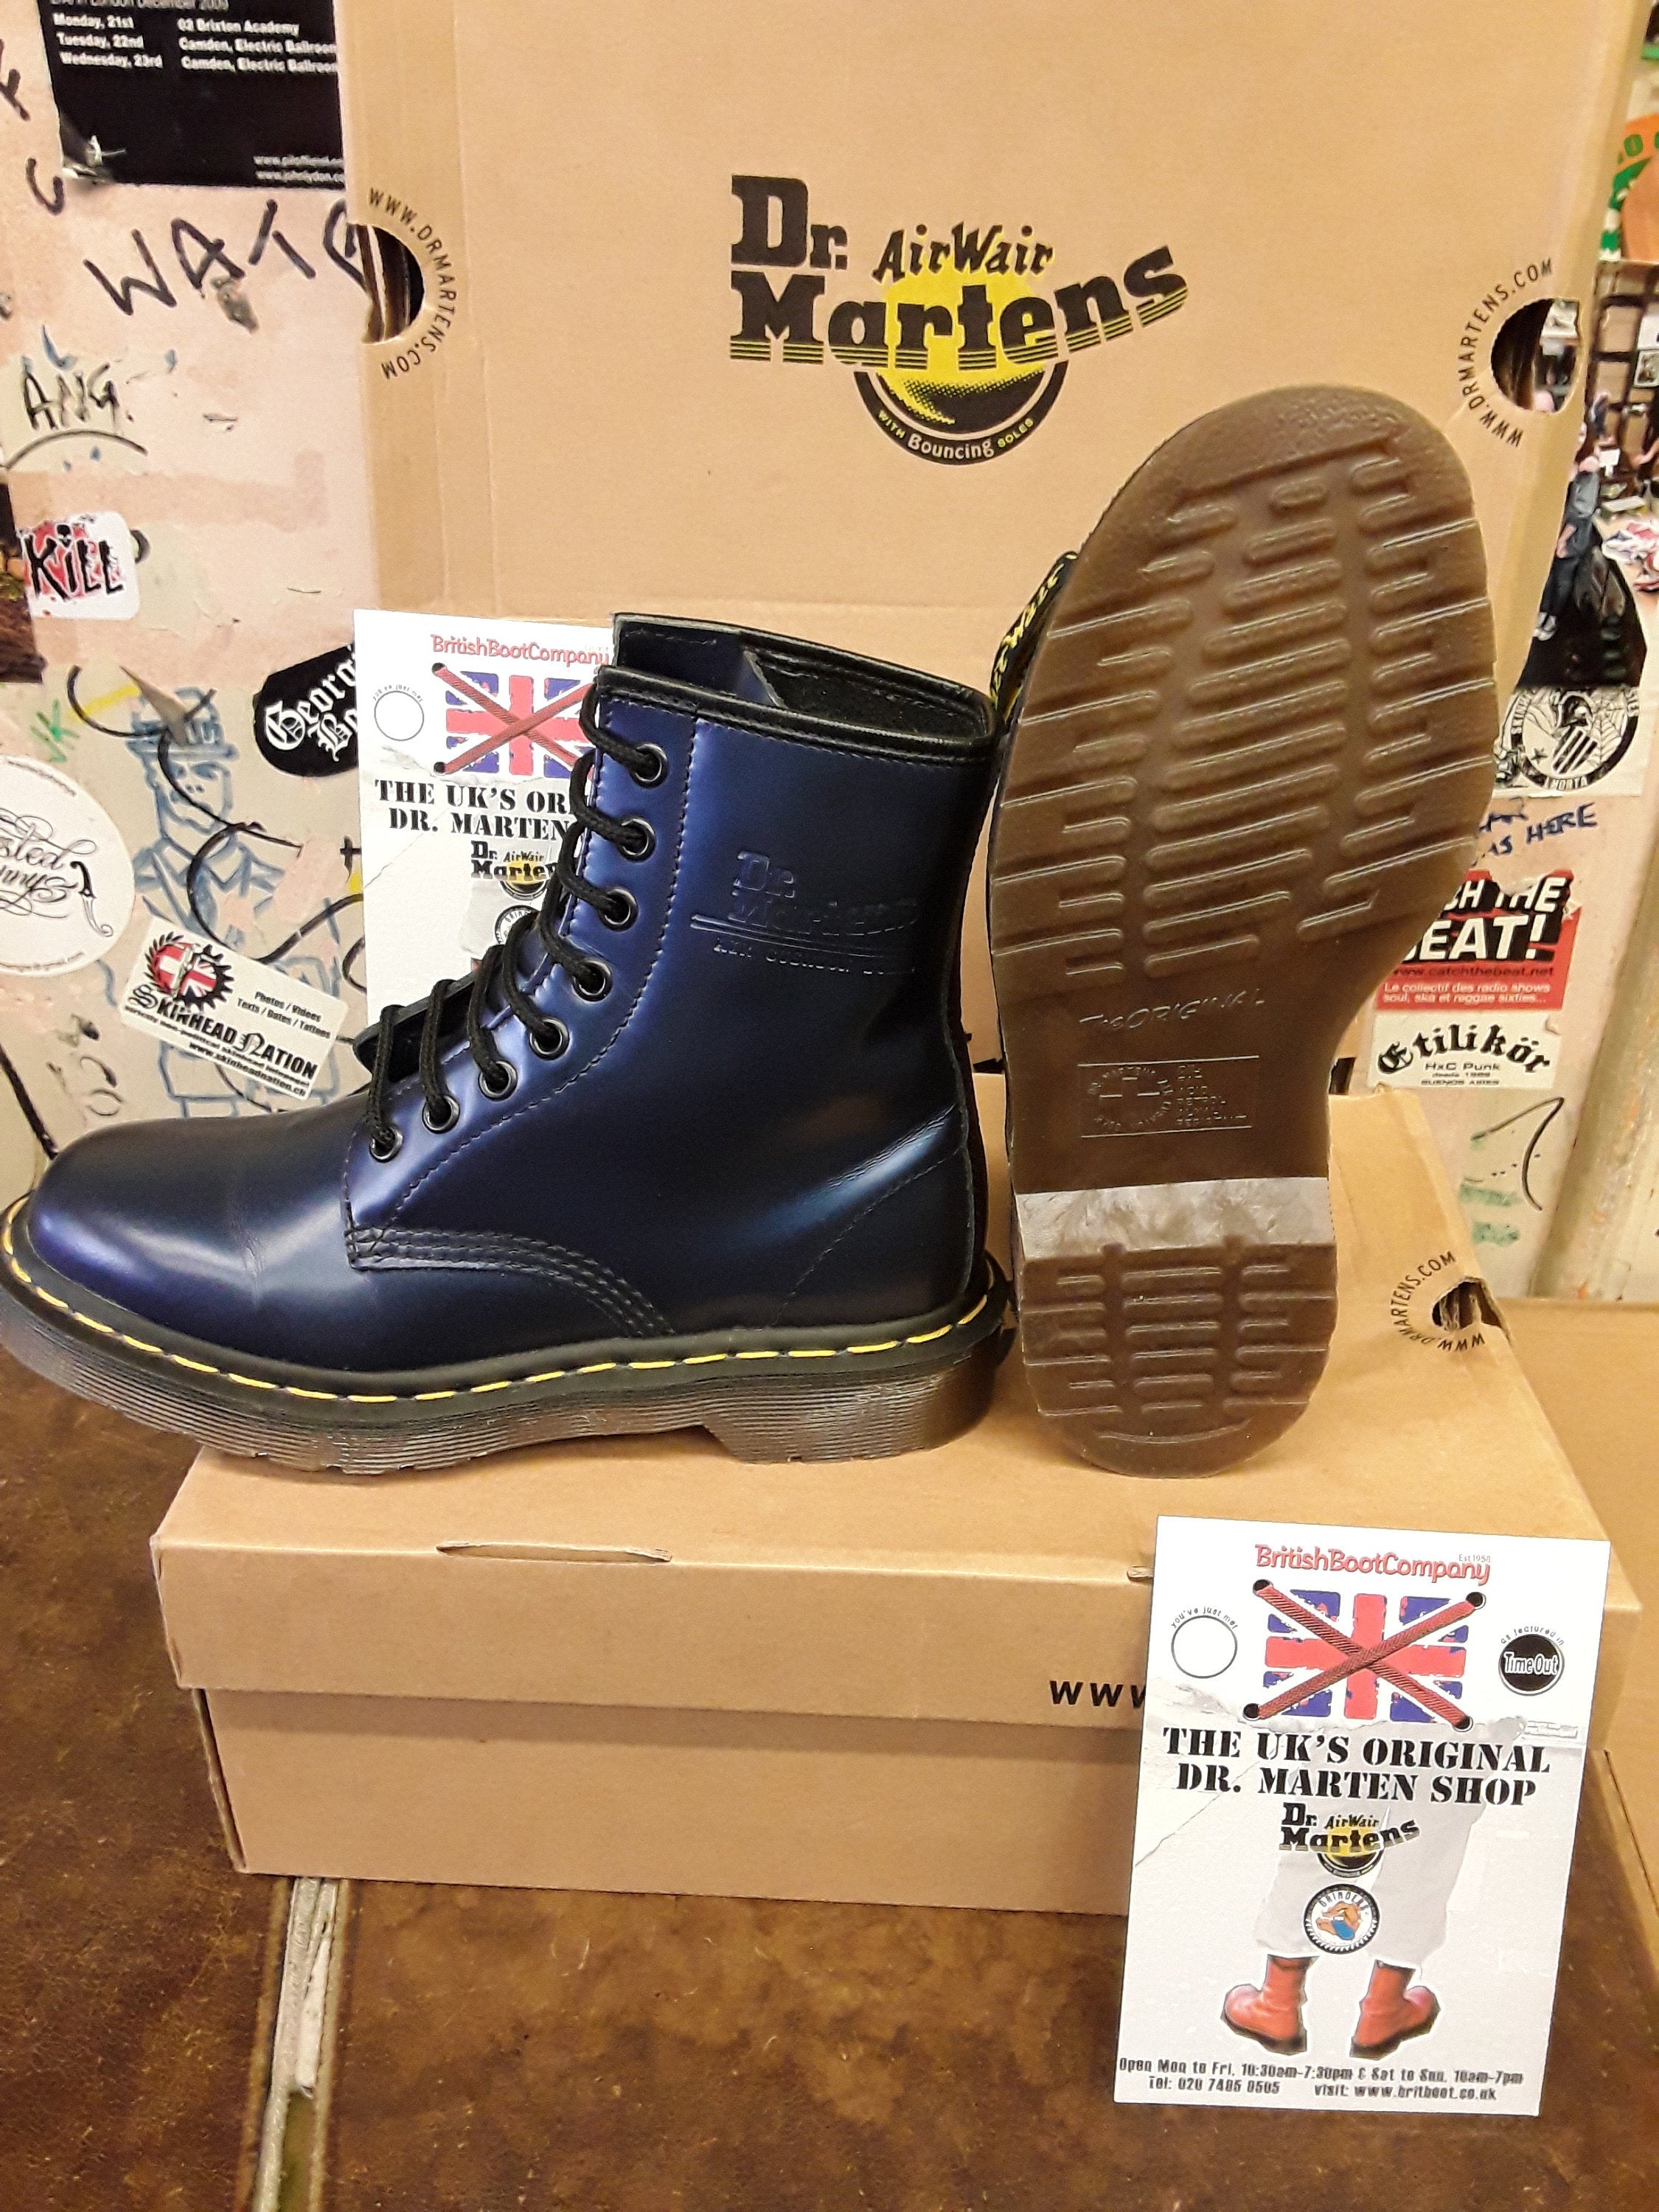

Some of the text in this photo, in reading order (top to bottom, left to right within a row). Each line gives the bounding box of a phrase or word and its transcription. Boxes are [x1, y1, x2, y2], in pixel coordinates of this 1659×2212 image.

[731, 175, 1054, 283] Dr. AirWair
[369, 187, 457, 380] WWW.DRMARTENS.COM
[728, 246, 1189, 370] Martens
[1458, 257, 1552, 448] WWW.DRMARTENS.COM
[908, 434, 995, 461] Bouncing
[375, 779, 435, 804] THE
[445, 785, 516, 811] UK'S
[389, 807, 439, 832] DR.
[471, 840, 498, 860] Dr.
[1403, 913, 1547, 961] EAT!
[1390, 1250, 1486, 1352] WWW.DRMARTENS.COM
[1255, 1544, 1492, 1587] BritishBootCompany
[1163, 1727, 1551, 1773] THE UK'S ORIGINAL
[1176, 1763, 1537, 1806] DR. MARTEN SHOP
[1279, 1819, 1420, 1852] Martens
[1281, 1802, 1379, 1829] Dr. AirWair
[1119, 2057, 1152, 2073] Open
[1158, 2059, 1186, 2073] Mon
[1192, 2060, 1206, 2074] to
[1371, 2067, 1394, 2081] Sat
[1402, 2067, 1414, 2081] to
[1454, 2070, 1523, 2086] 10am-7pm
[1178, 2077, 1203, 2091] 020
[1354, 2085, 1498, 2101] www.britboot.co.uk
